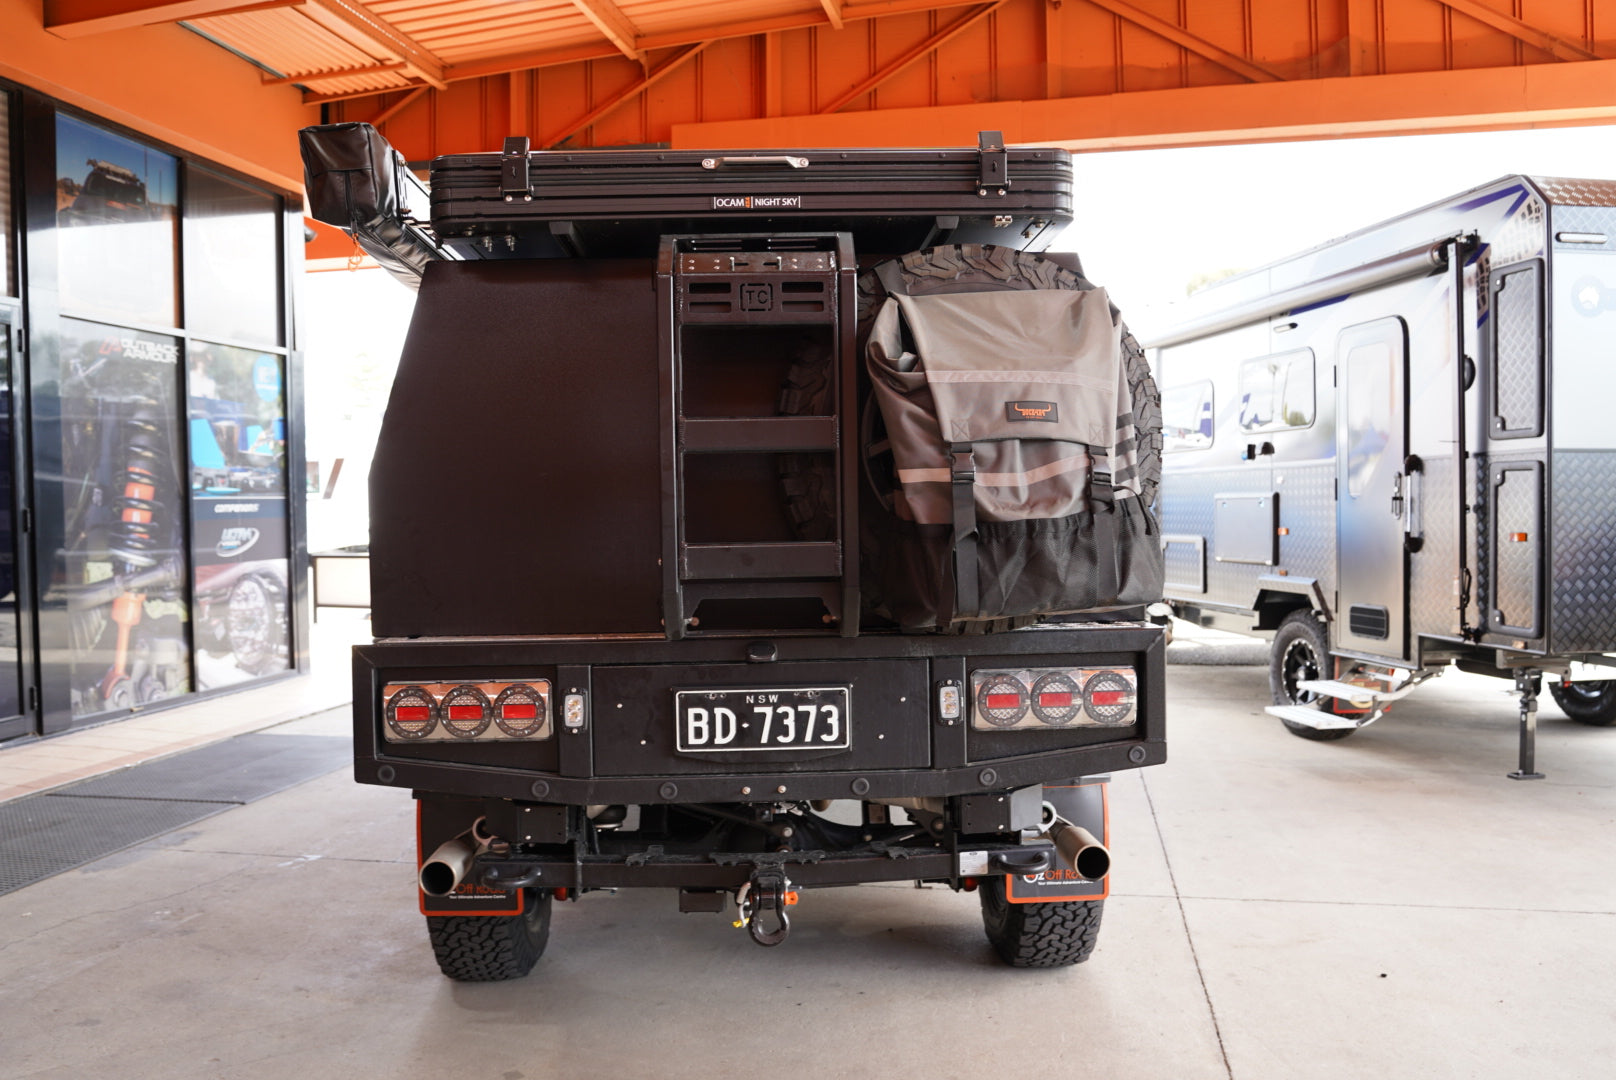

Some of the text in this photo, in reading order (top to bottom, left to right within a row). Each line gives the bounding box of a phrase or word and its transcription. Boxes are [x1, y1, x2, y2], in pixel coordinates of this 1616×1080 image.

[716, 198, 744, 207] OCAM
[755, 198, 780, 206] NIGHT
[781, 197, 798, 206] SKY
[121, 338, 179, 357] OUTBACK
[123, 347, 178, 364] ARMOUR
[745, 694, 779, 704] NSW
[1066, 870, 1083, 879] Ro
